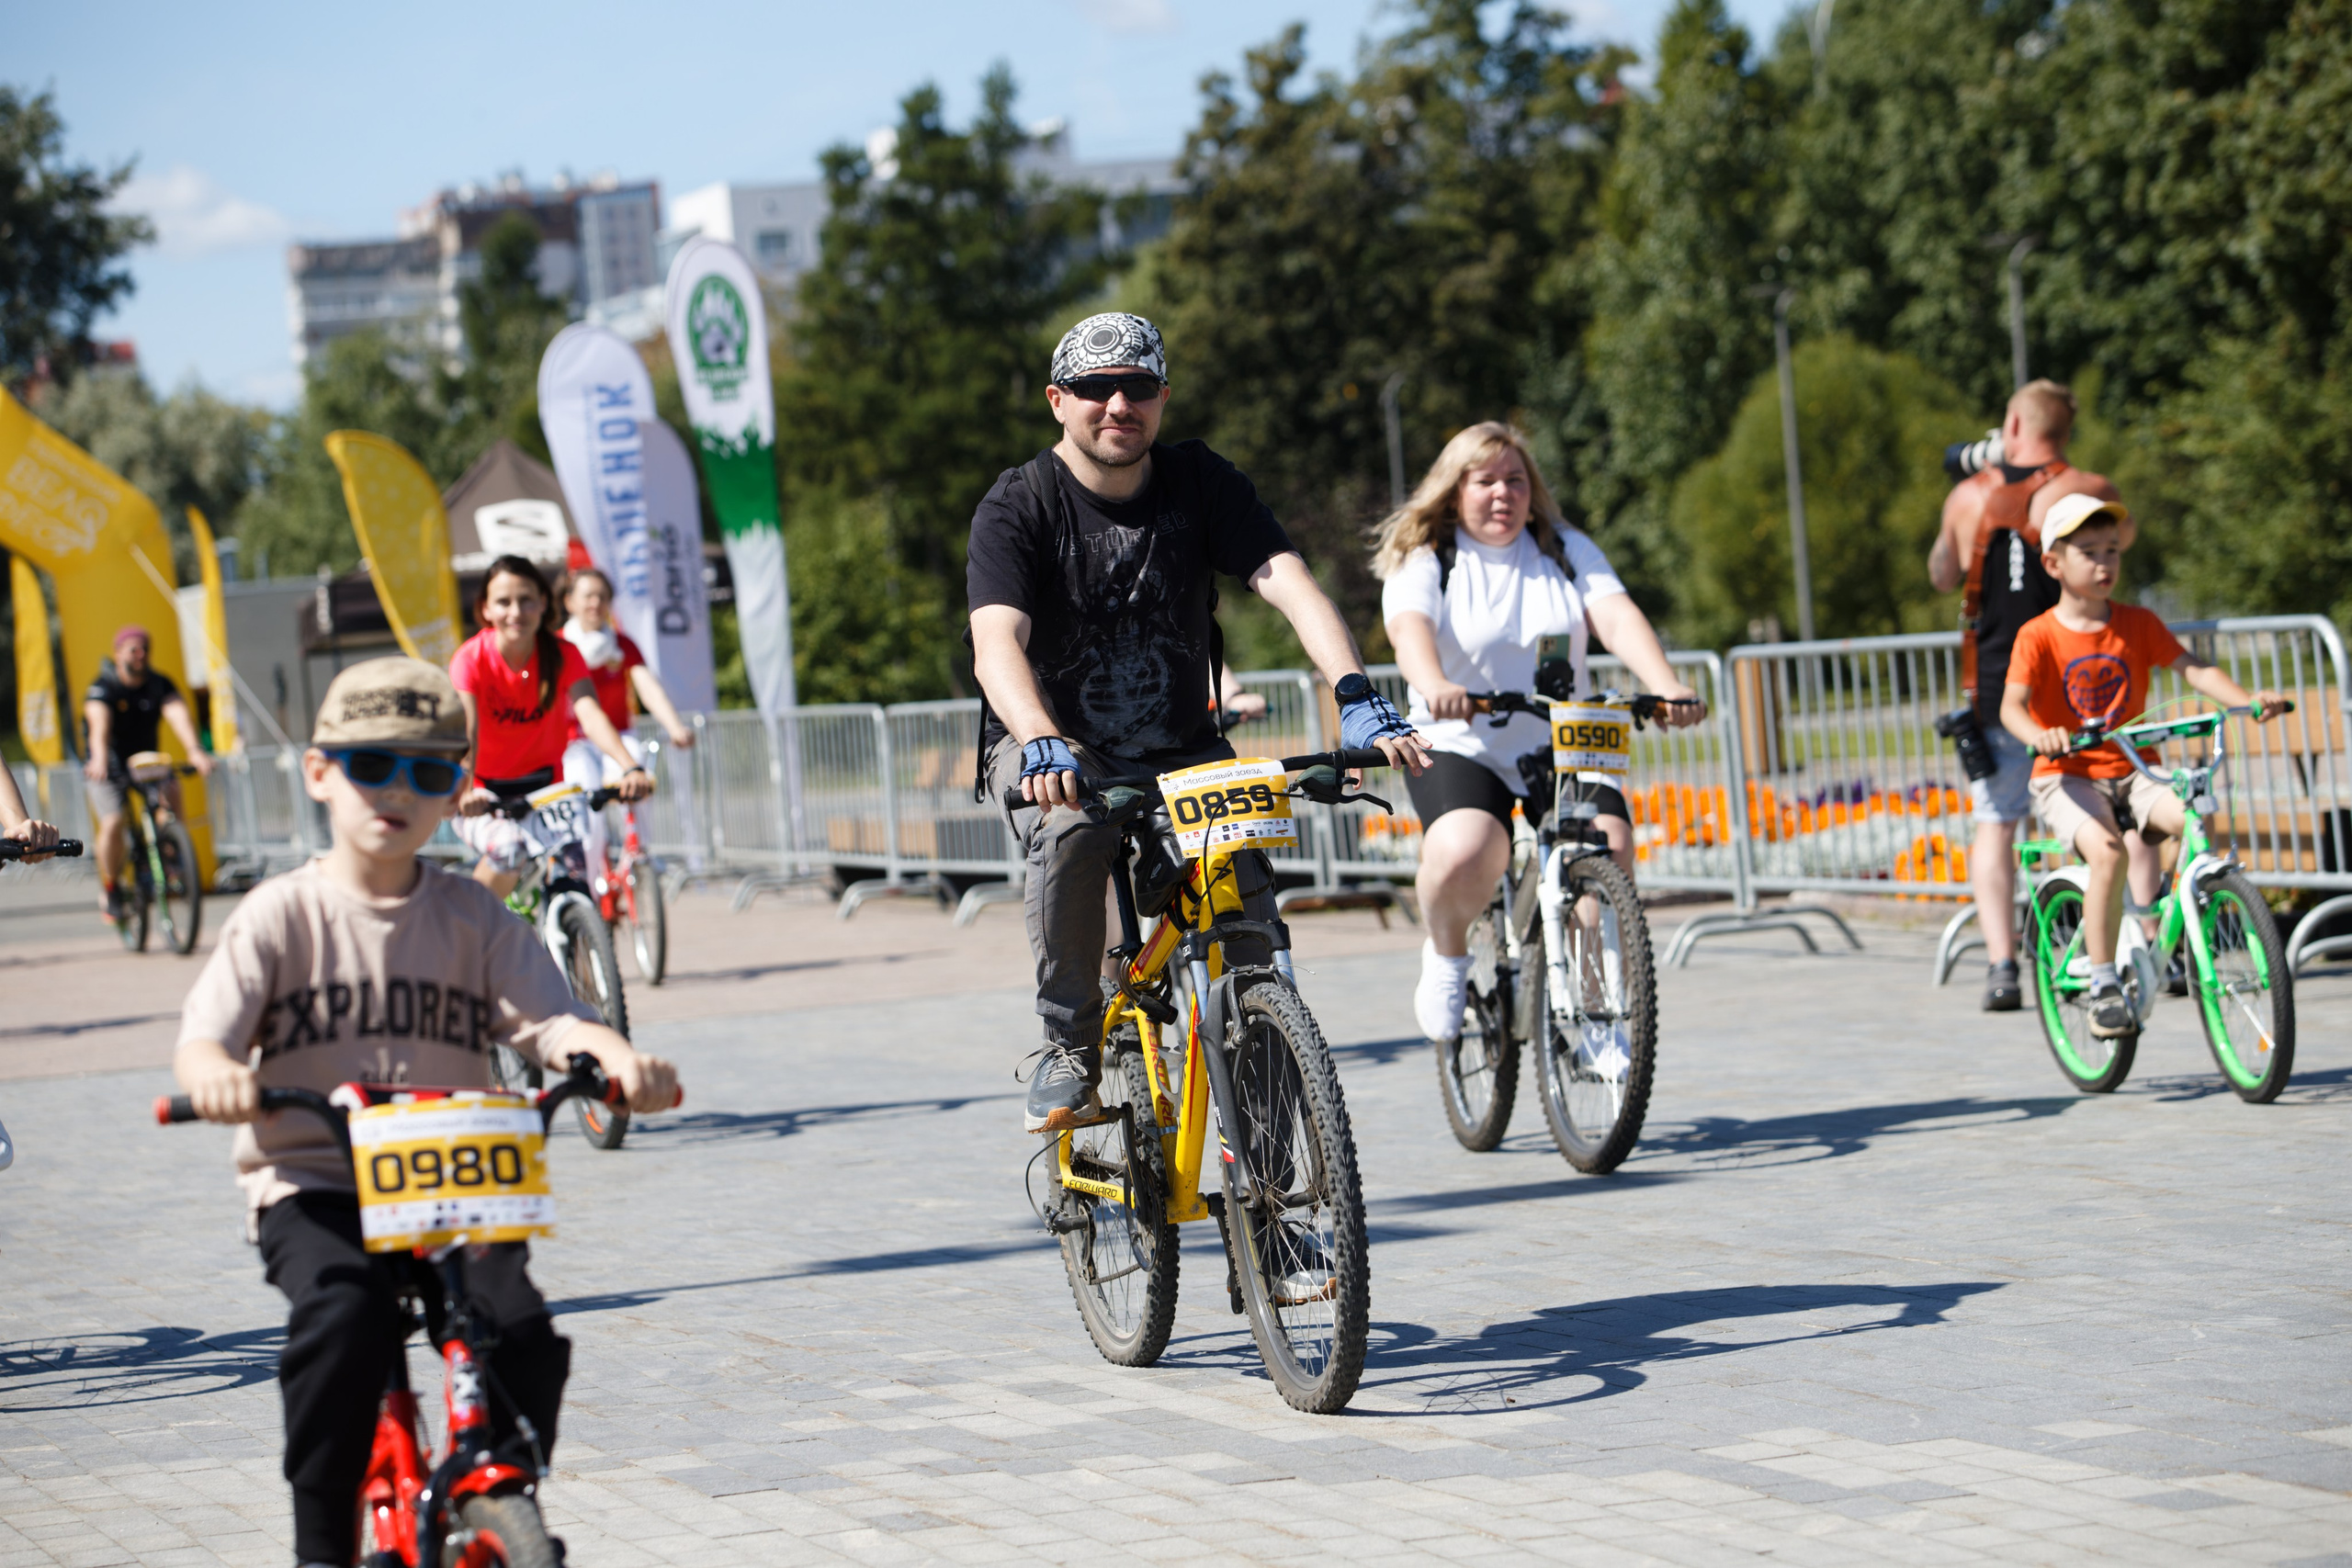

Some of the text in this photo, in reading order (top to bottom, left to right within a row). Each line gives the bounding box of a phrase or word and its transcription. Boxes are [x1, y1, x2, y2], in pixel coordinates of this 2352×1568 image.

[1055, 510, 1190, 558] ISTURBED
[1559, 726, 1620, 749] 0590
[1182, 768, 1263, 786] Массовый заезд
[1174, 784, 1275, 825] 0859
[260, 977, 491, 1059] EXPLORER
[371, 1145, 523, 1193] 0980
[1069, 1179, 1118, 1198] FORWARD
